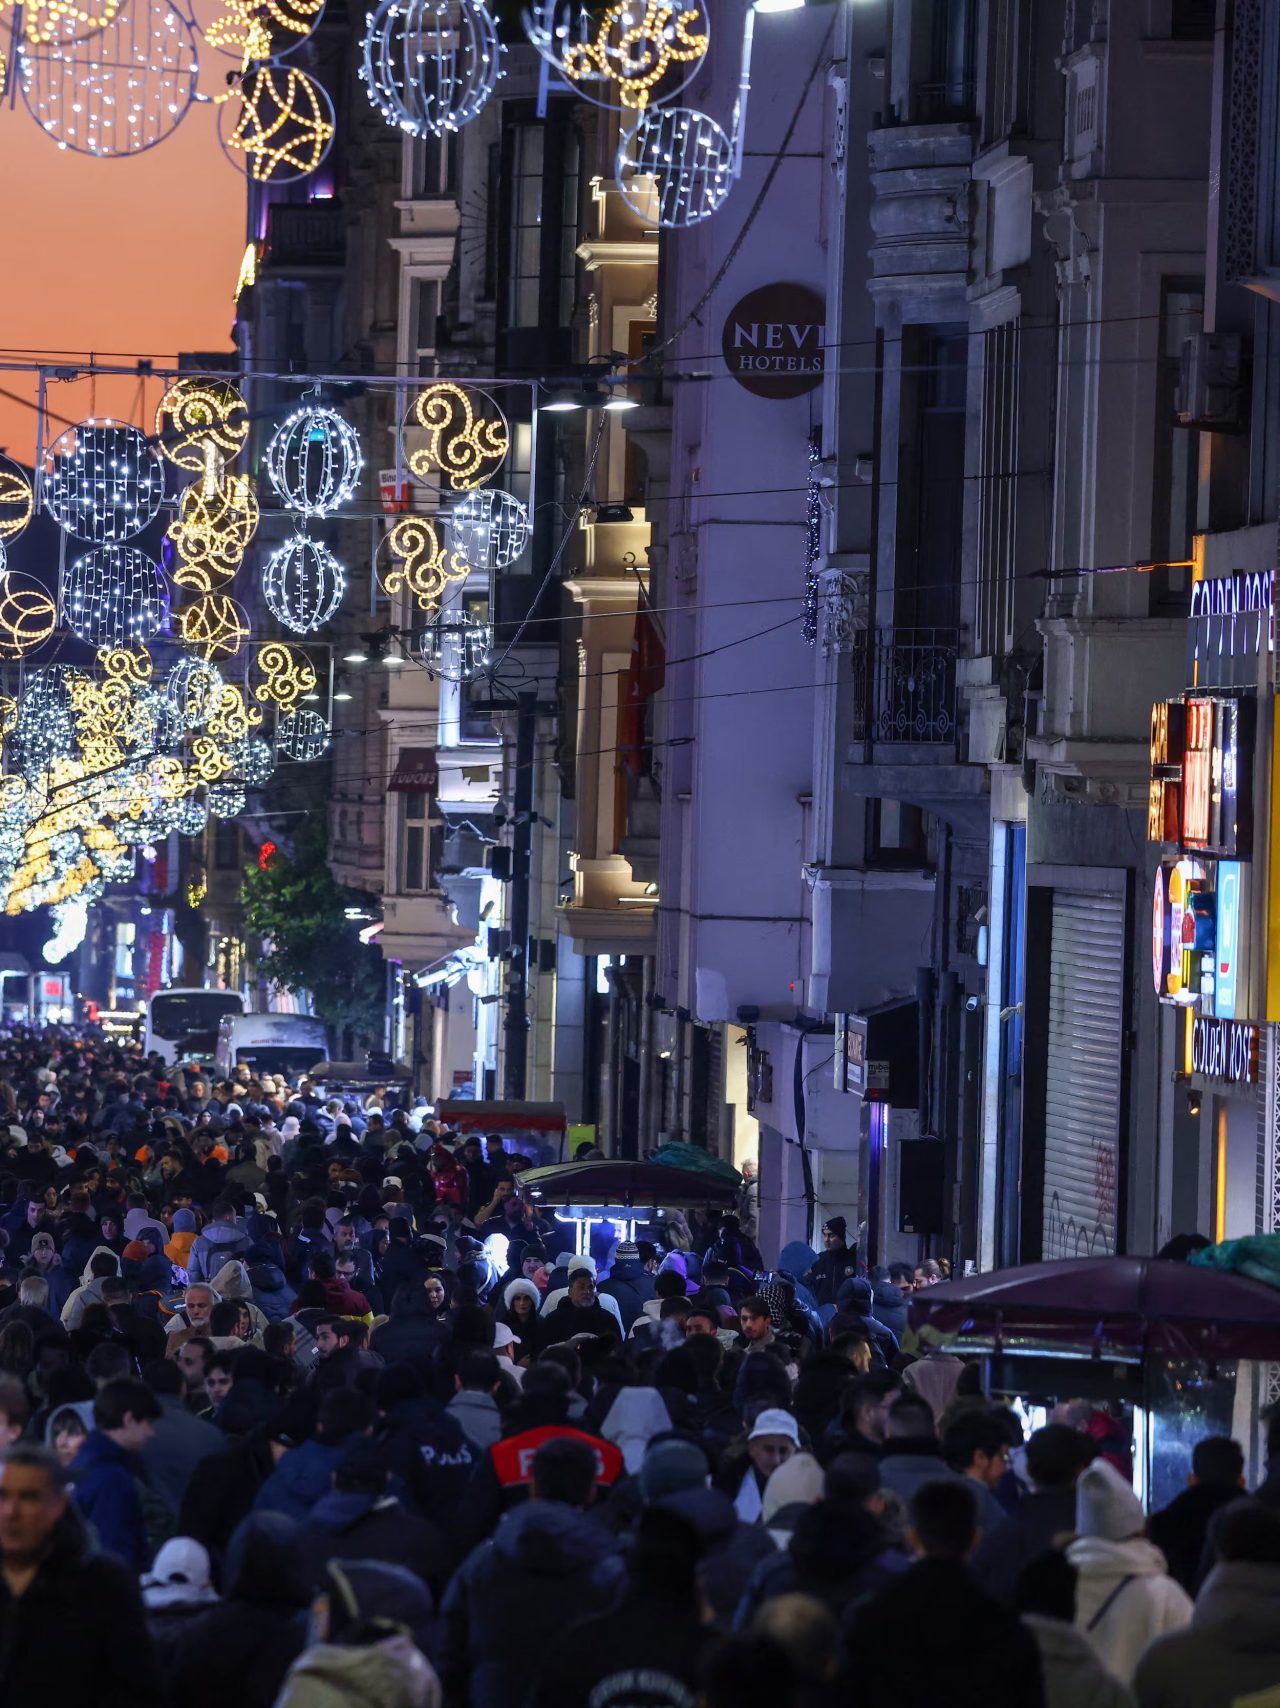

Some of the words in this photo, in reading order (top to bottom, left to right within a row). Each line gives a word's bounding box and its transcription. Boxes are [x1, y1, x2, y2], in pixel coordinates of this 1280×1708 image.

[739, 355, 821, 371] HOTELS
[1192, 1018, 1228, 1077] GOLDEN
[1229, 1023, 1253, 1083] ROSE
